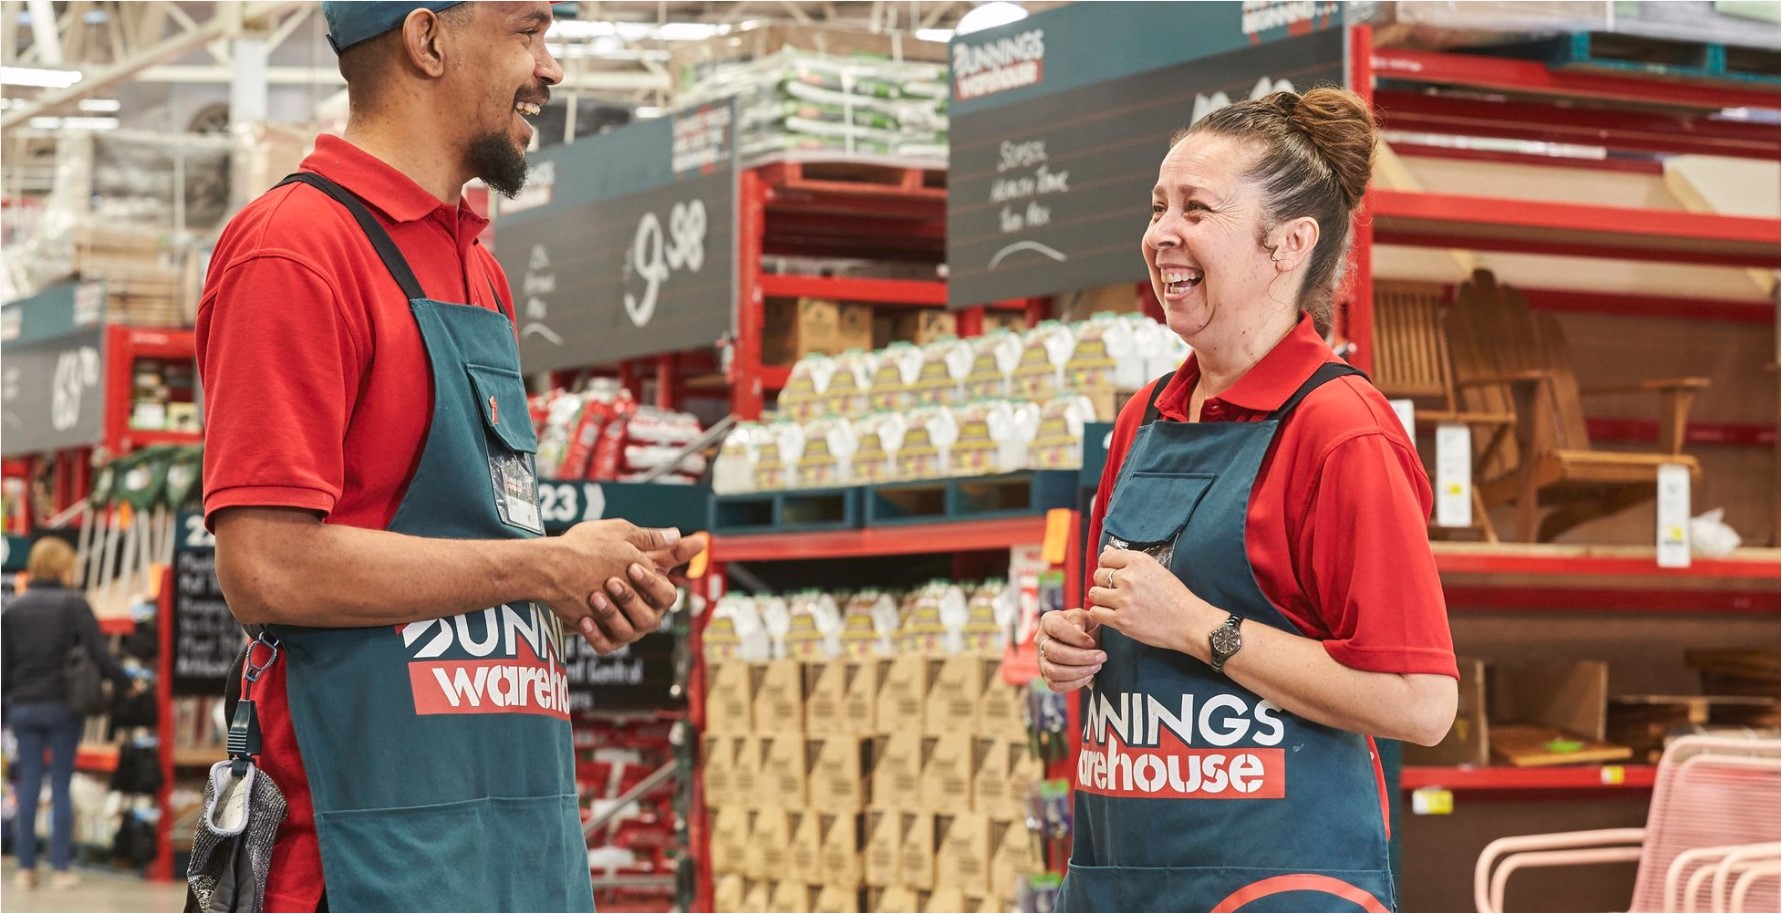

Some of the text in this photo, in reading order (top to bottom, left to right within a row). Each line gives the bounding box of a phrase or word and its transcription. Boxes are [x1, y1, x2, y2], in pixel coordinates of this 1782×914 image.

[953, 28, 1044, 78] BUNNINGS
[538, 483, 578, 522] 23
[1082, 691, 1284, 746] NNINGS
[1078, 733, 1265, 793] arehouse
